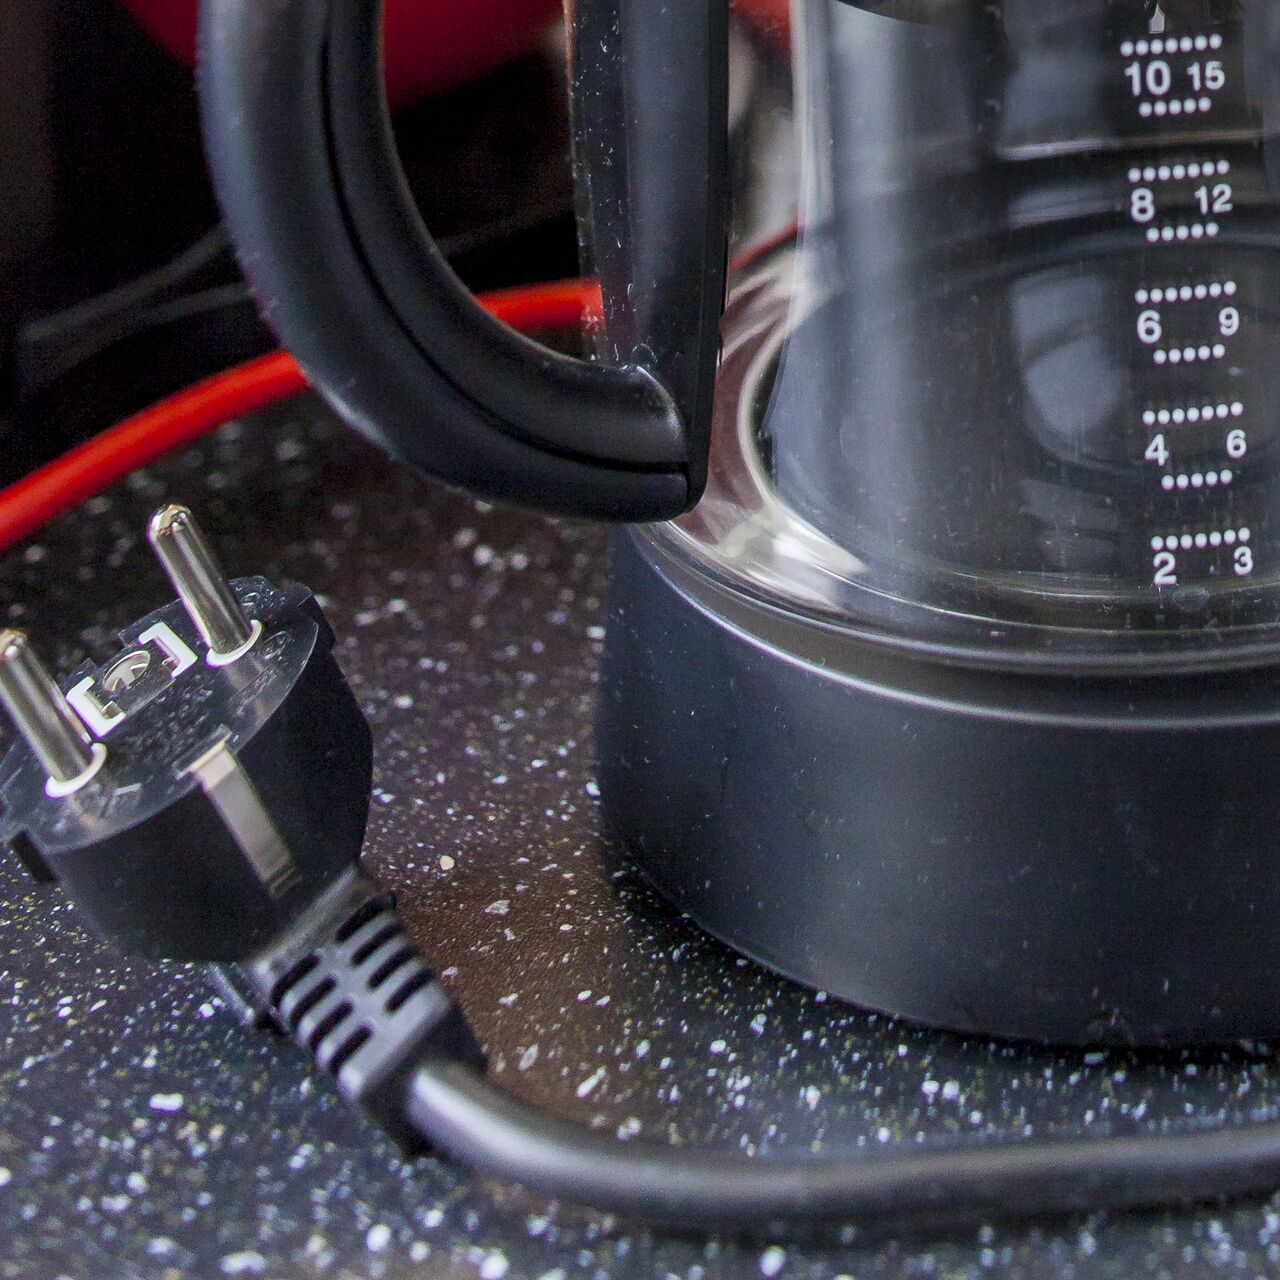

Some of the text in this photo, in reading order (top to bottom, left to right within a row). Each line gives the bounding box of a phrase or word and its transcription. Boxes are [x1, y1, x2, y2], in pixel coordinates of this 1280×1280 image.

[1125, 60, 1226, 96] 10 15
[1130, 183, 1234, 222] 8 12
[1136, 306, 1240, 345] 6 9
[1144, 428, 1247, 466] 4 6
[1153, 546, 1254, 586] 2 3
